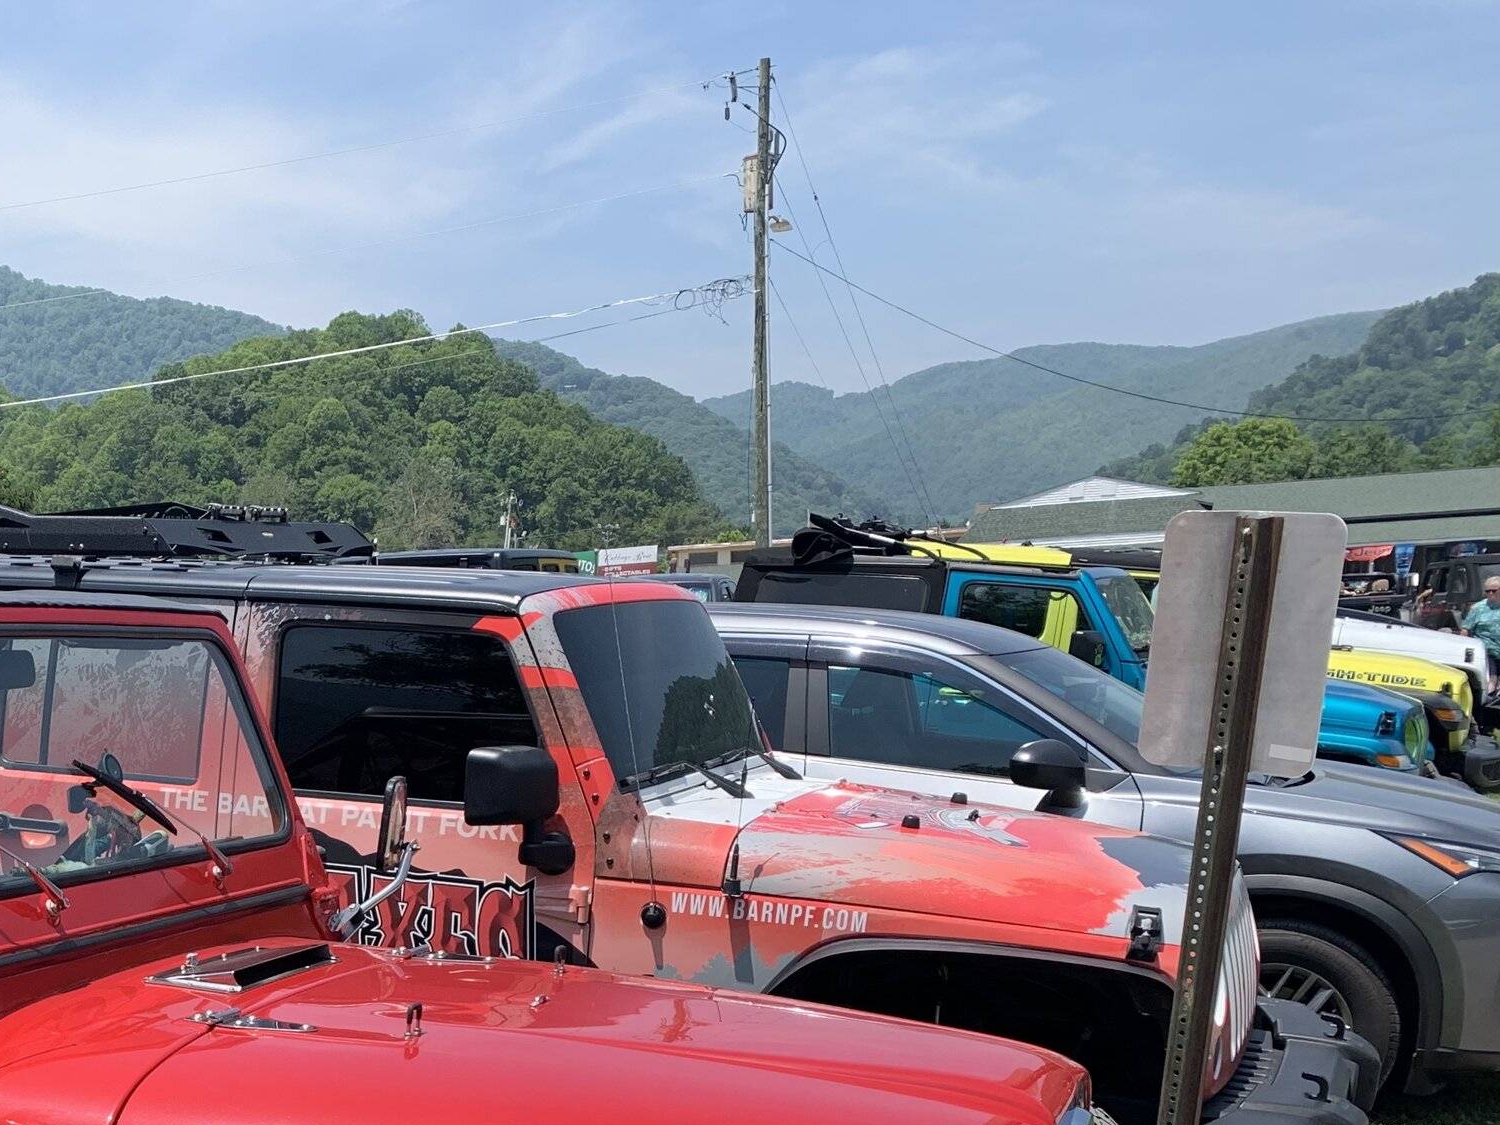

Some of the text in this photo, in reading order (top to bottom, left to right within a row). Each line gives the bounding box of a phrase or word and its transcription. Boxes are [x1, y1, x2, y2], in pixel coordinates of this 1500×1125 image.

[160, 786, 209, 813] THE
[219, 792, 268, 818] BAR
[440, 815, 521, 842] FORK
[671, 891, 868, 933] WWW.BARNPF.COM
